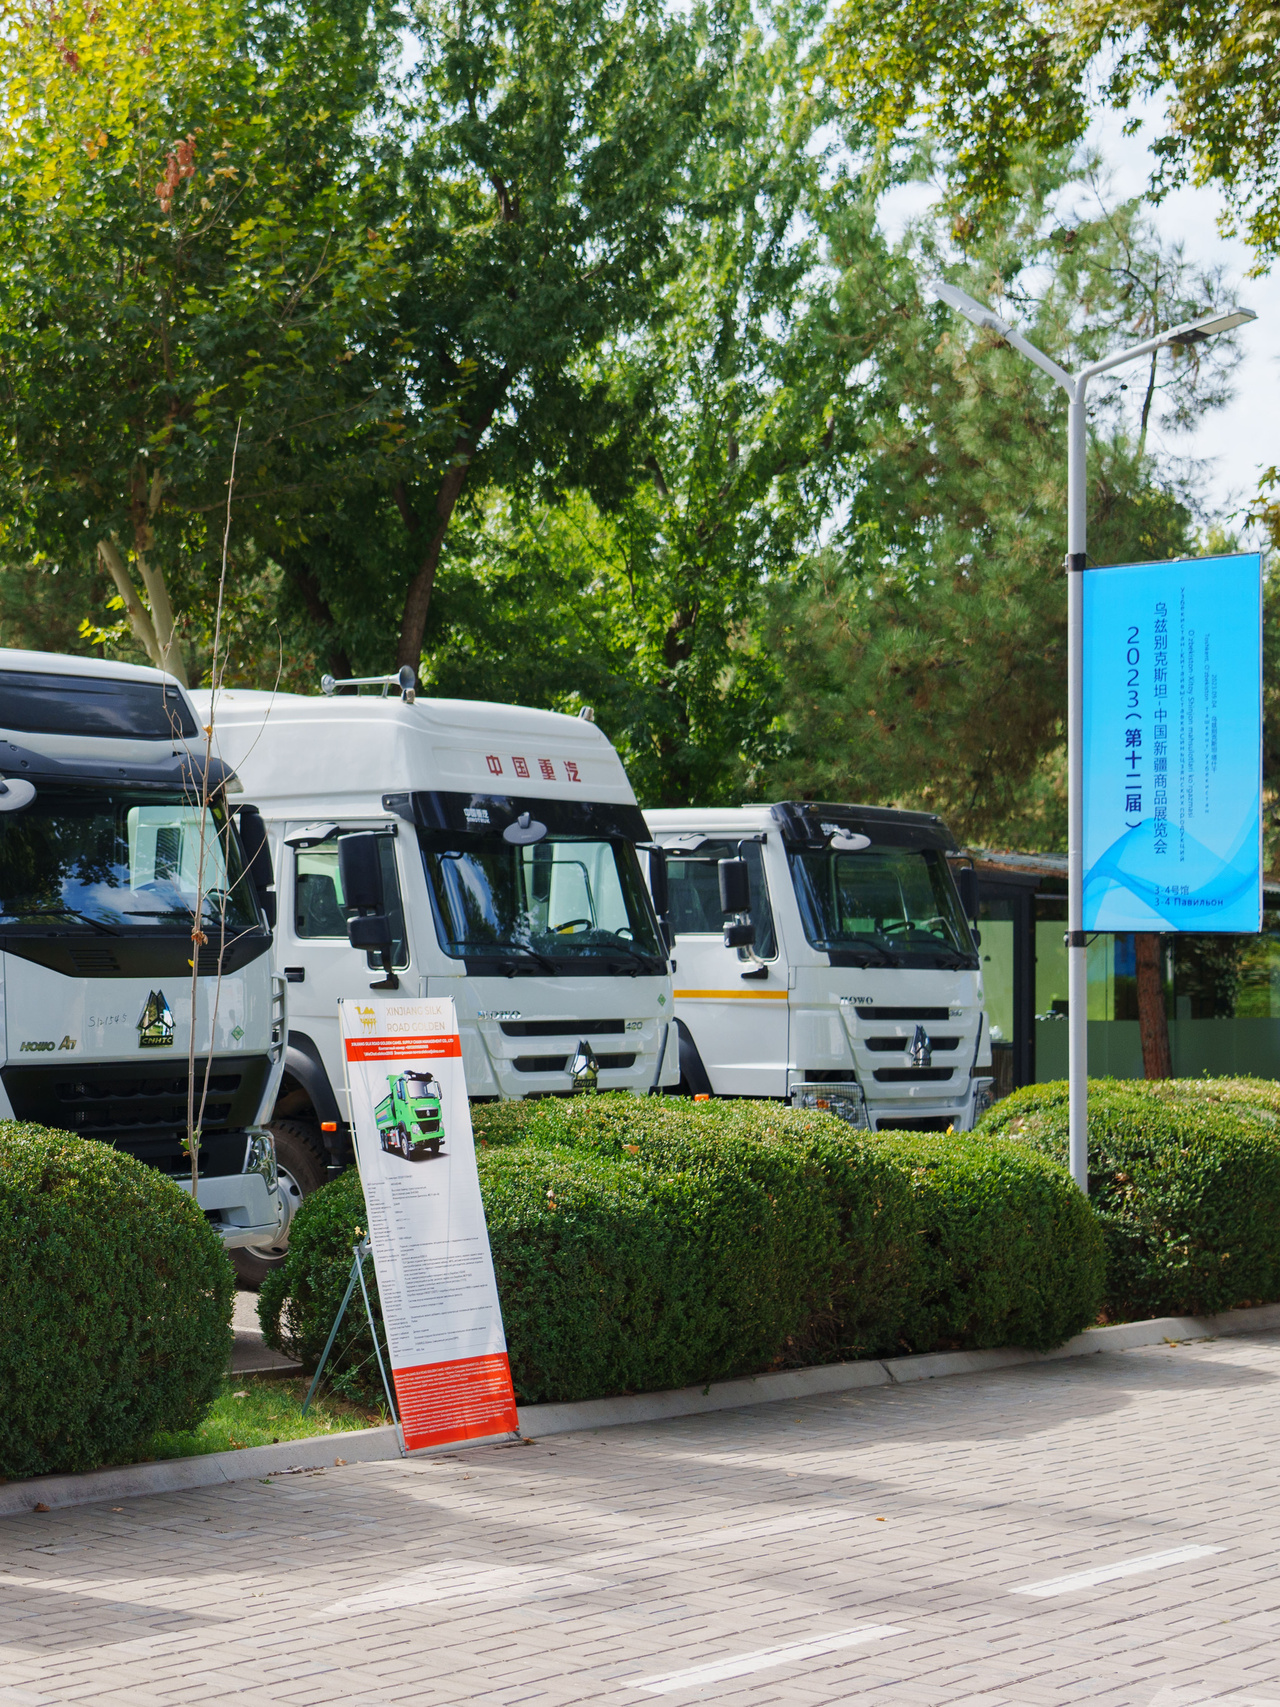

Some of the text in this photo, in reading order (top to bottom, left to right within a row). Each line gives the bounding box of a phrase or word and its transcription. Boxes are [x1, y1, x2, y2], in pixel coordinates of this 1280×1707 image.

[485, 755, 582, 783] 中国重汽
[1154, 885, 1189, 896] 3-4号馆
[1154, 897, 1224, 907] 3-4 Павильон
[840, 996, 874, 1005] HOWO
[386, 1006, 442, 1016] XINJIANG SILK
[387, 1022, 446, 1032] ROAD GOLDEN
[625, 1021, 643, 1030] 420
[141, 1037, 173, 1045] CNHTC
[20, 1041, 56, 1052] HOWO
